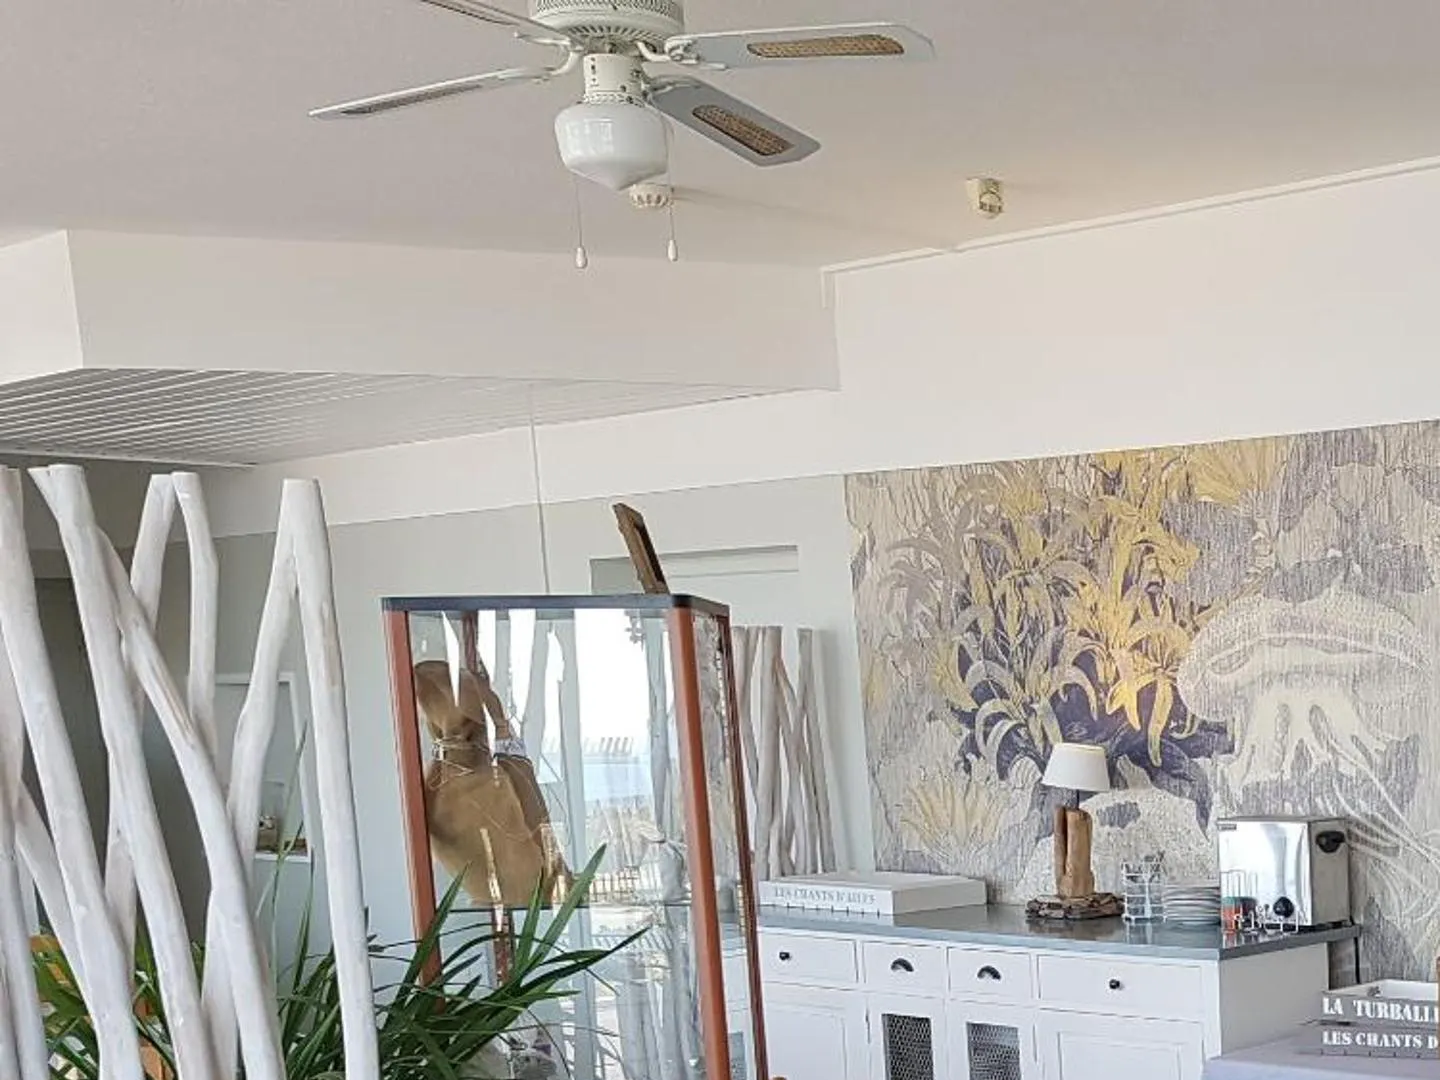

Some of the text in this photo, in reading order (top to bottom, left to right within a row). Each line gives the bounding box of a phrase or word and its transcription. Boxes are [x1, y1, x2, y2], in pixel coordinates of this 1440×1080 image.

[1322, 997, 1344, 1016] LA
[1322, 1031, 1352, 1046] LES
[1355, 1032, 1423, 1048] CHANTS
